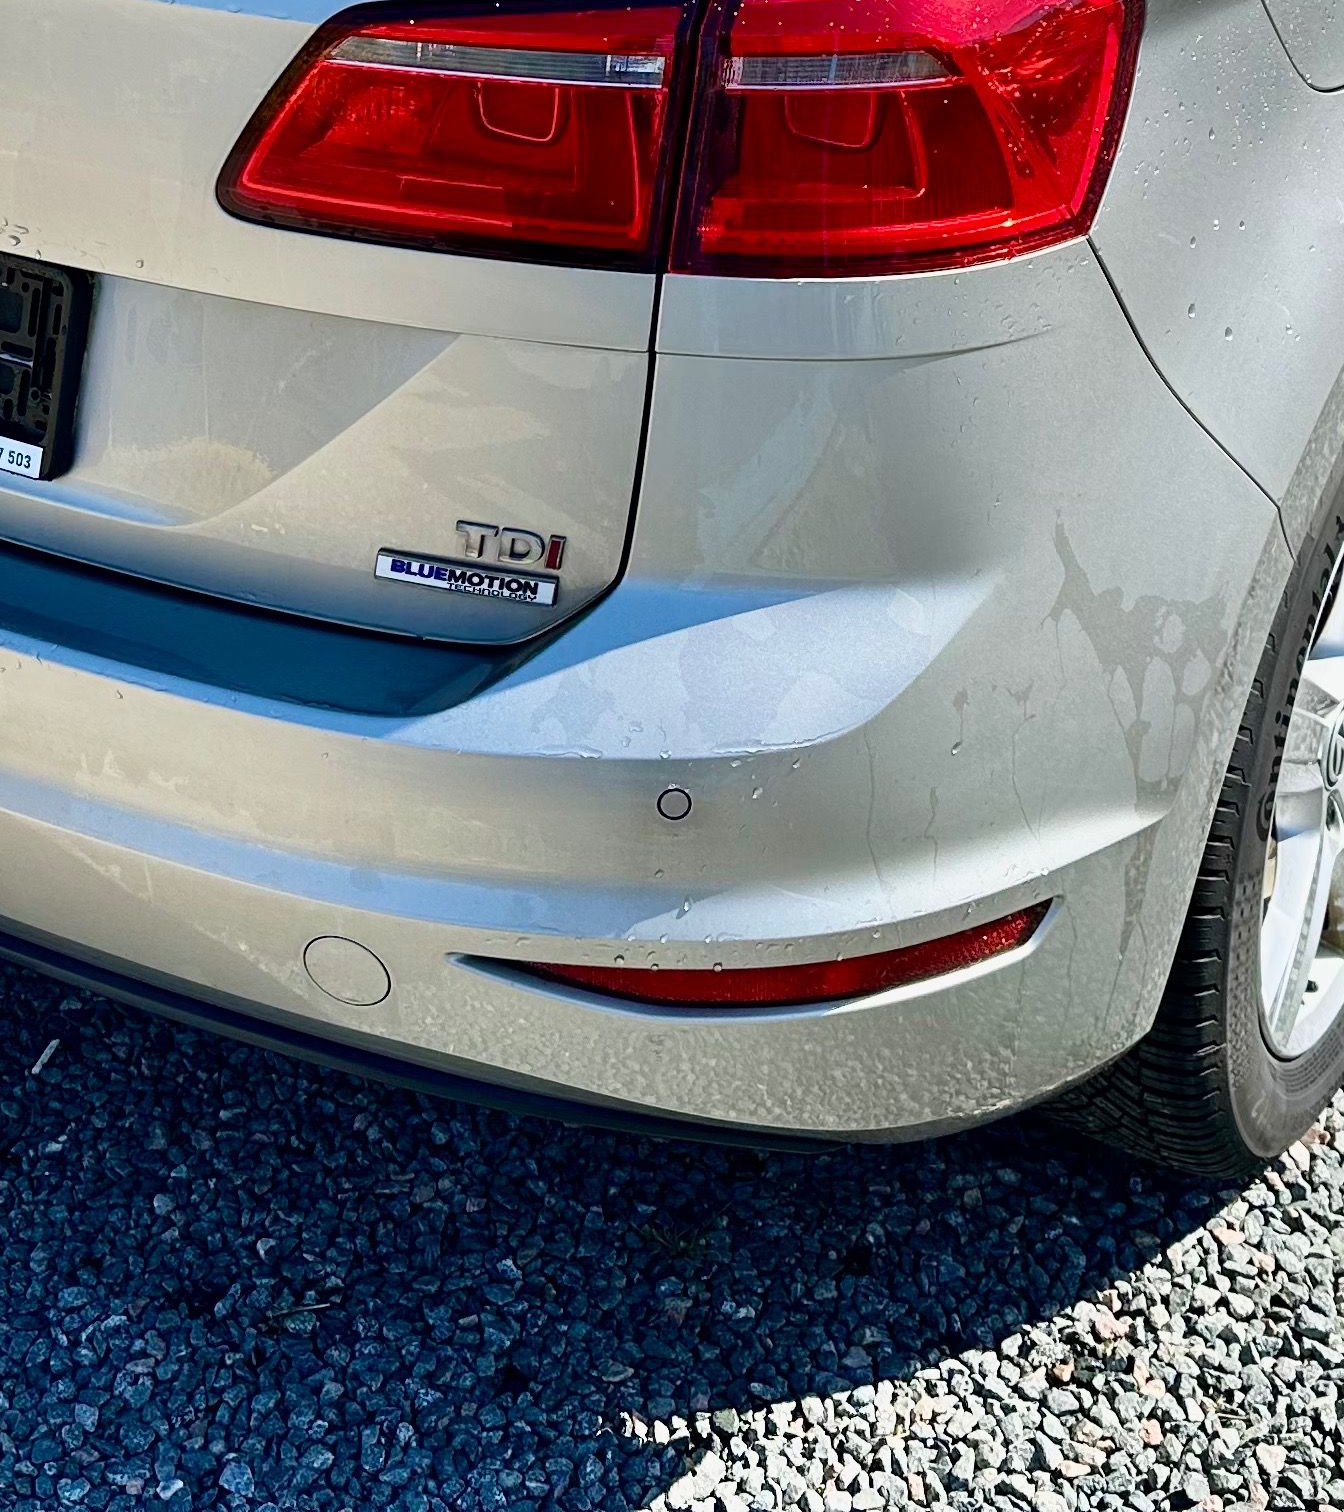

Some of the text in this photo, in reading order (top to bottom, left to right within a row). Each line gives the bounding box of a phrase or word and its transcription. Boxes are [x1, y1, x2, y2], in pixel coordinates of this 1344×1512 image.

[8, 450, 32, 469] 503
[456, 520, 566, 571] TDI
[390, 558, 539, 595] BLUEMOTION
[447, 582, 537, 602] TECHNOLOGY
